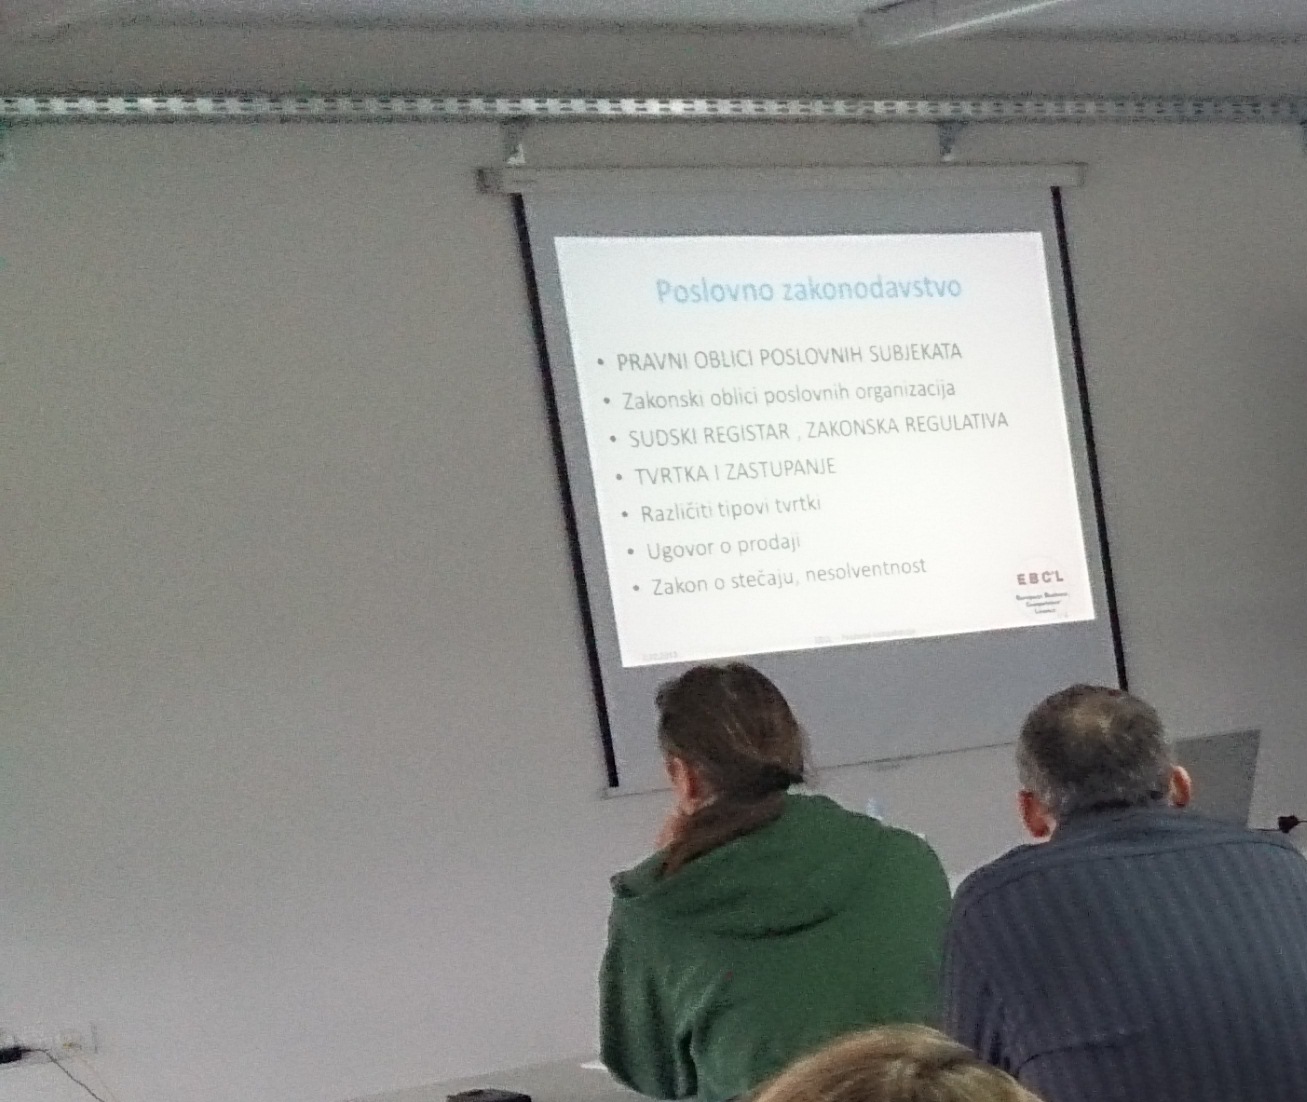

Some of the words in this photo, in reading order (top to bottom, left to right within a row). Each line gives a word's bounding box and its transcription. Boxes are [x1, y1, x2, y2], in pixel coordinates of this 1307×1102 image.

[656, 276, 773, 302] Poslovno
[782, 274, 962, 301] zakonodavstvo
[617, 352, 688, 372] PRAVNI
[694, 349, 754, 369] OBLICI
[760, 347, 863, 366] POSLOVNIH
[869, 343, 962, 363] SUBJEKATA
[622, 389, 704, 410] Zakonski
[710, 386, 758, 407] oblici
[764, 383, 850, 406] poslovnih
[855, 379, 956, 403] organizacija
[628, 427, 698, 449] SUDSKI
[703, 422, 790, 444] REGISTAR
[806, 417, 900, 439] ZAKONSKA
[905, 412, 1009, 433] REGULATIVA
[635, 466, 710, 486] TVRTKA
[725, 457, 836, 480] ZASTUPANJE
[718, 498, 769, 520] tipovi
[775, 493, 822, 514] tvrtki
[646, 541, 714, 563] Ugovor
[720, 541, 731, 554] o
[737, 532, 802, 556] prodaji
[651, 577, 708, 596] Zakon
[714, 577, 725, 590] o
[806, 558, 927, 582] nesolventnost
